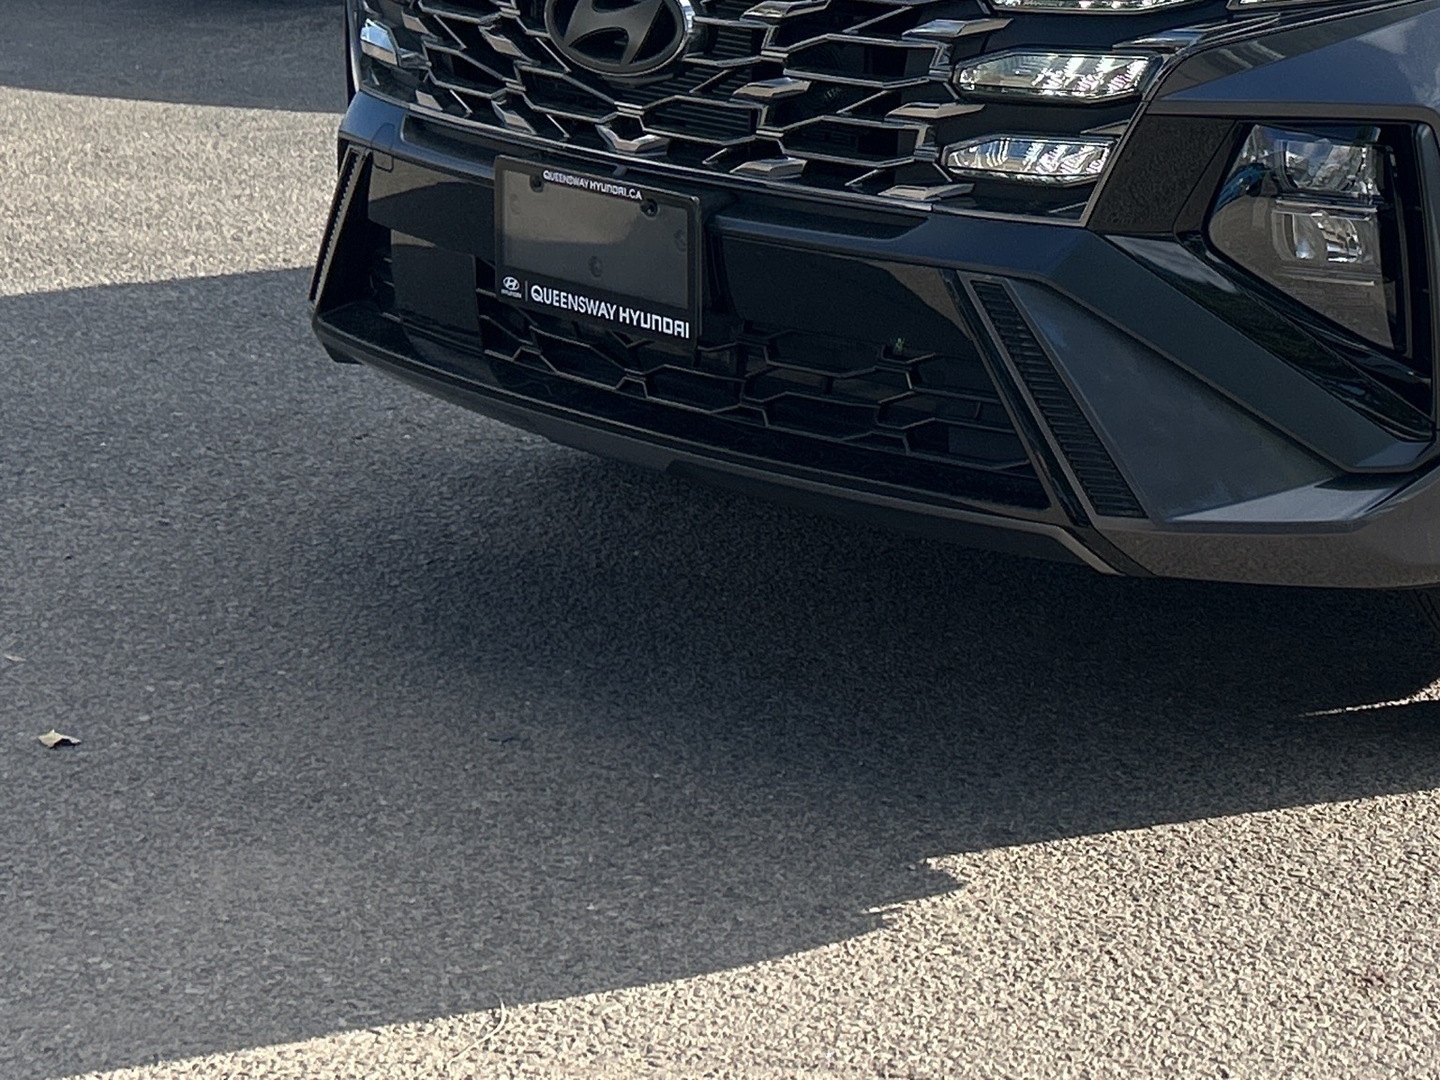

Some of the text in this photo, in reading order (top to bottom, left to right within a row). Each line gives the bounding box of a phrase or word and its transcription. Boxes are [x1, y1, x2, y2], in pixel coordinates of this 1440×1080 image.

[589, 181, 642, 201] HYUNDAI.CA
[530, 284, 690, 339] QUEENSWAY HYUNDAI
